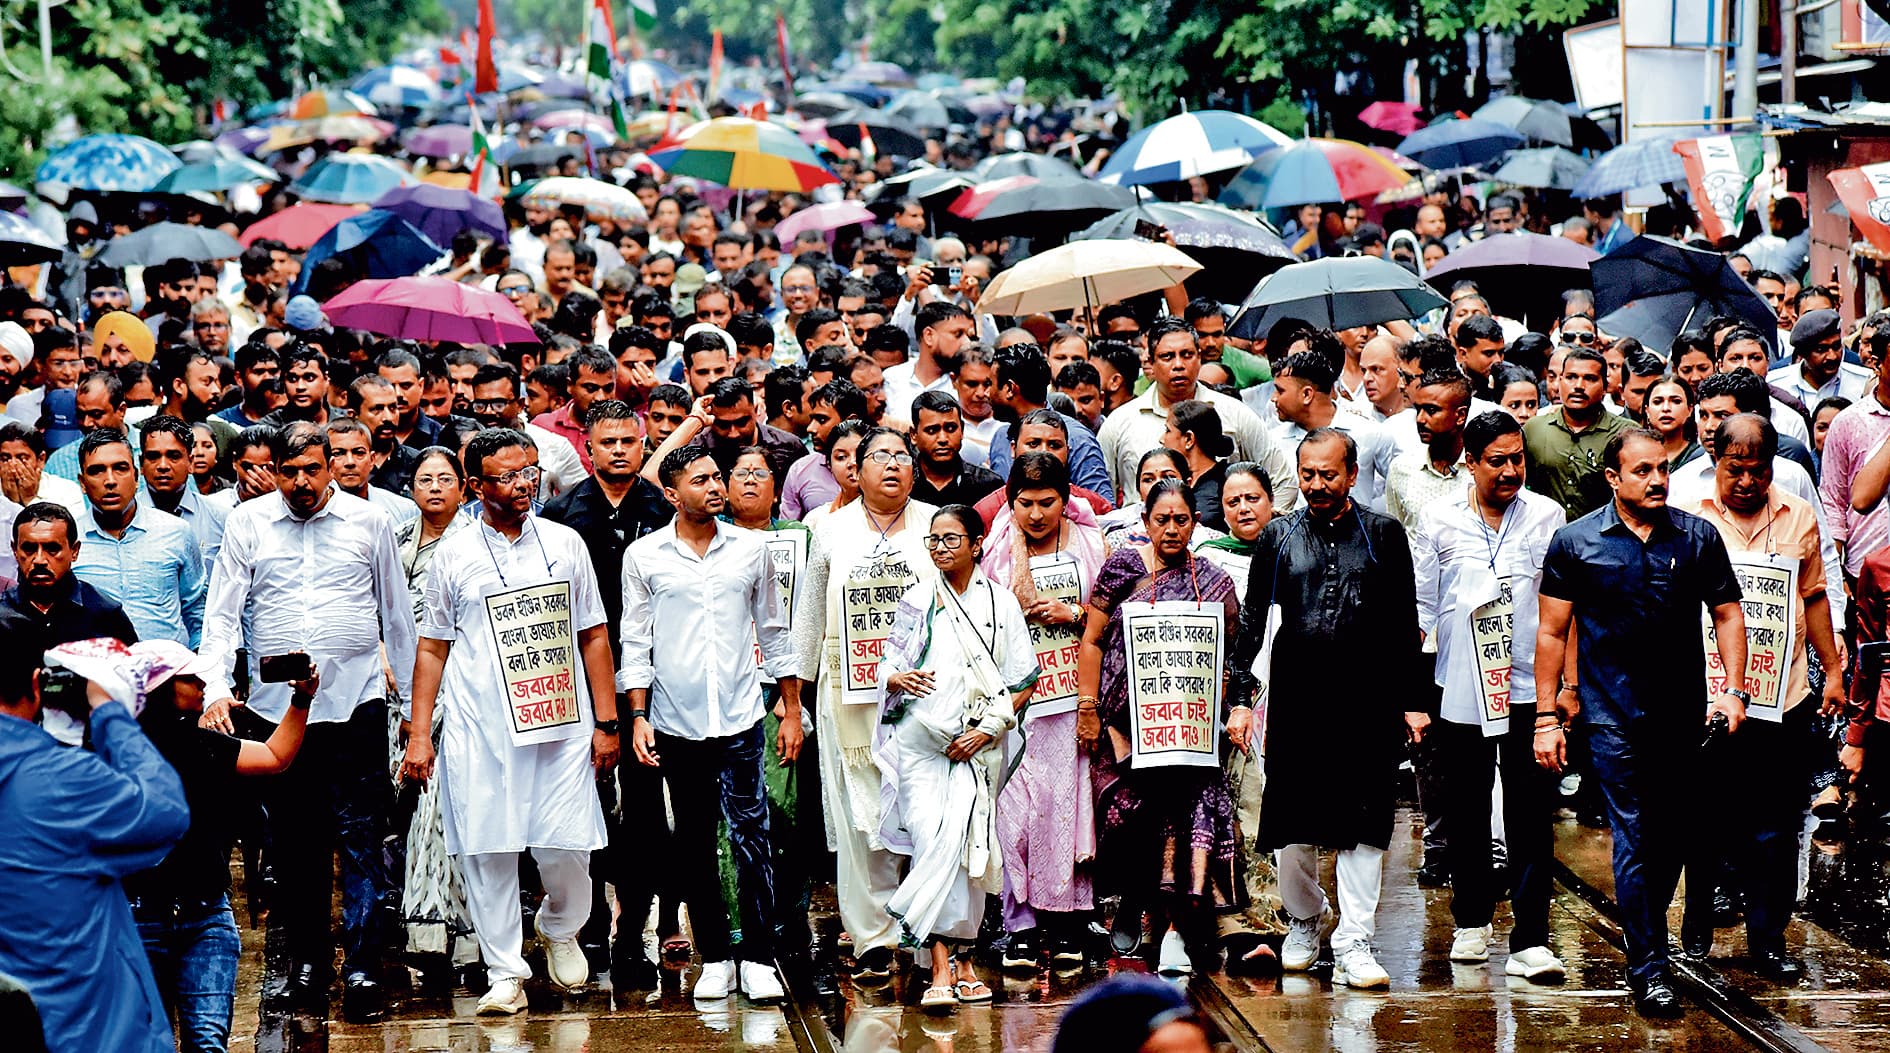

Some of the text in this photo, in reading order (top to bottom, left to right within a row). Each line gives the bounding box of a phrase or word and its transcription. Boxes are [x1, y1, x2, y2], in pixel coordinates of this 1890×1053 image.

[1043, 572, 1077, 593] সরকার,
[1757, 576, 1787, 600] সরকার,
[848, 587, 871, 606] বাংলা
[493, 604, 517, 622] ডবল
[851, 613, 867, 632] বলা
[868, 607, 881, 630] কি
[1766, 603, 1784, 622] কথা
[499, 627, 527, 648] বাংলা
[528, 621, 557, 645] ভাষায়
[1136, 626, 1156, 643] ডবল
[1184, 625, 1215, 645] সরকার,
[1476, 615, 1504, 636] বাংলা
[851, 637, 887, 660] জবা
[1777, 630, 1784, 648] ?
[506, 654, 526, 673] বলা
[527, 646, 540, 670] কি
[1137, 651, 1213, 670] বাংলা ভাষায় কথা
[1482, 642, 1501, 661] বলা
[1751, 649, 1777, 678] চাই,
[511, 675, 556, 699] জবাব
[1140, 671, 1213, 696] বলা কি অপরাধ ?
[1765, 681, 1775, 701] !!
[516, 699, 556, 726] জবাব
[1140, 697, 1211, 724] জবাব চাই,
[1142, 725, 1209, 749] জবাব দাও !!
